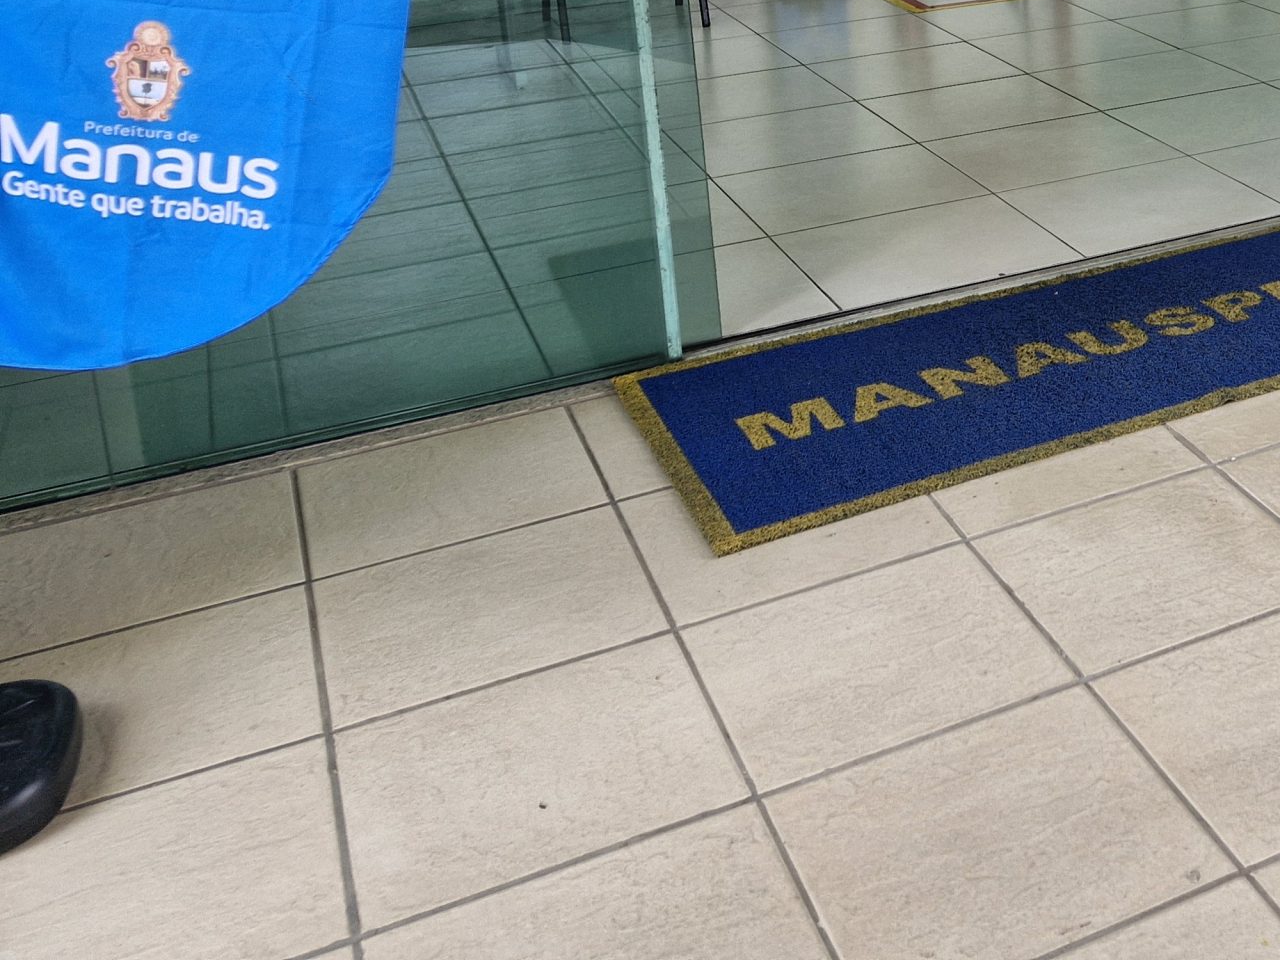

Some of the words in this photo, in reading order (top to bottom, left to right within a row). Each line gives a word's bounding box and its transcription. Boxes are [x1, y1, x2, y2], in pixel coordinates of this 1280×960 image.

[0, 113, 280, 200] Manaus
[84, 120, 172, 141] Prefeitura
[178, 130, 200, 143] de
[2, 170, 85, 208] Gente
[91, 193, 144, 218] que
[151, 194, 272, 231] trabalha.
